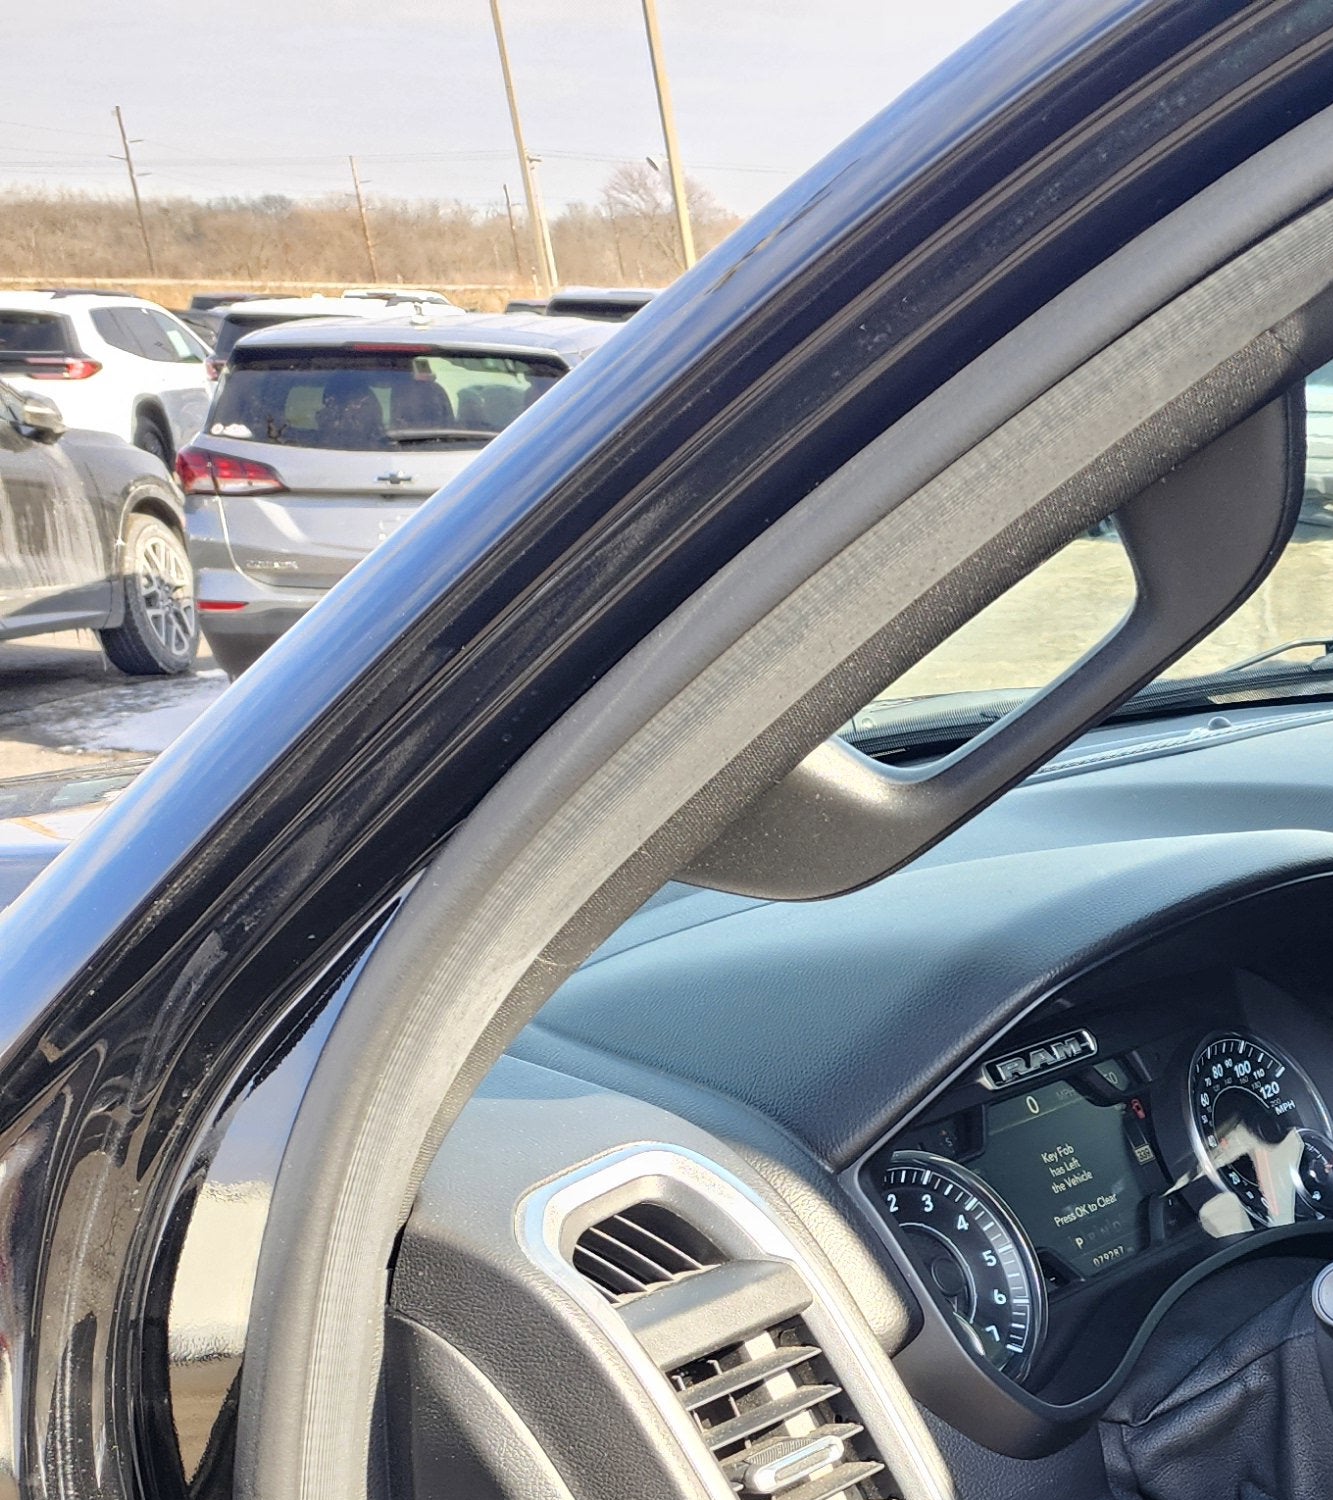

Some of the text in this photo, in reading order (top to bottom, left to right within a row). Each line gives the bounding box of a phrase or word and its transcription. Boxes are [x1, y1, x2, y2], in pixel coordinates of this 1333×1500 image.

[995, 1036, 1083, 1083] RAM
[1211, 1063, 1224, 1080] 80
[1233, 1060, 1252, 1079] 100
[1252, 1068, 1266, 1081] 110
[1258, 1081, 1280, 1100] 120
[1026, 1095, 1040, 1114] 0
[1200, 1092, 1210, 1108] 60
[1274, 1099, 1296, 1116] MPH
[1041, 1143, 1075, 1163] Key Fob
[1049, 1157, 1081, 1178] has Left
[1051, 1170, 1093, 1194] the Vehicle
[886, 1194, 899, 1212] 2
[921, 1194, 934, 1213] 3
[1054, 1193, 1118, 1228] Press OK to Clear
[956, 1214, 969, 1232] 4
[1075, 1237, 1084, 1249] P
[982, 1250, 997, 1267] 5
[993, 1288, 1006, 1305] 6
[985, 1324, 1000, 1342] 7
